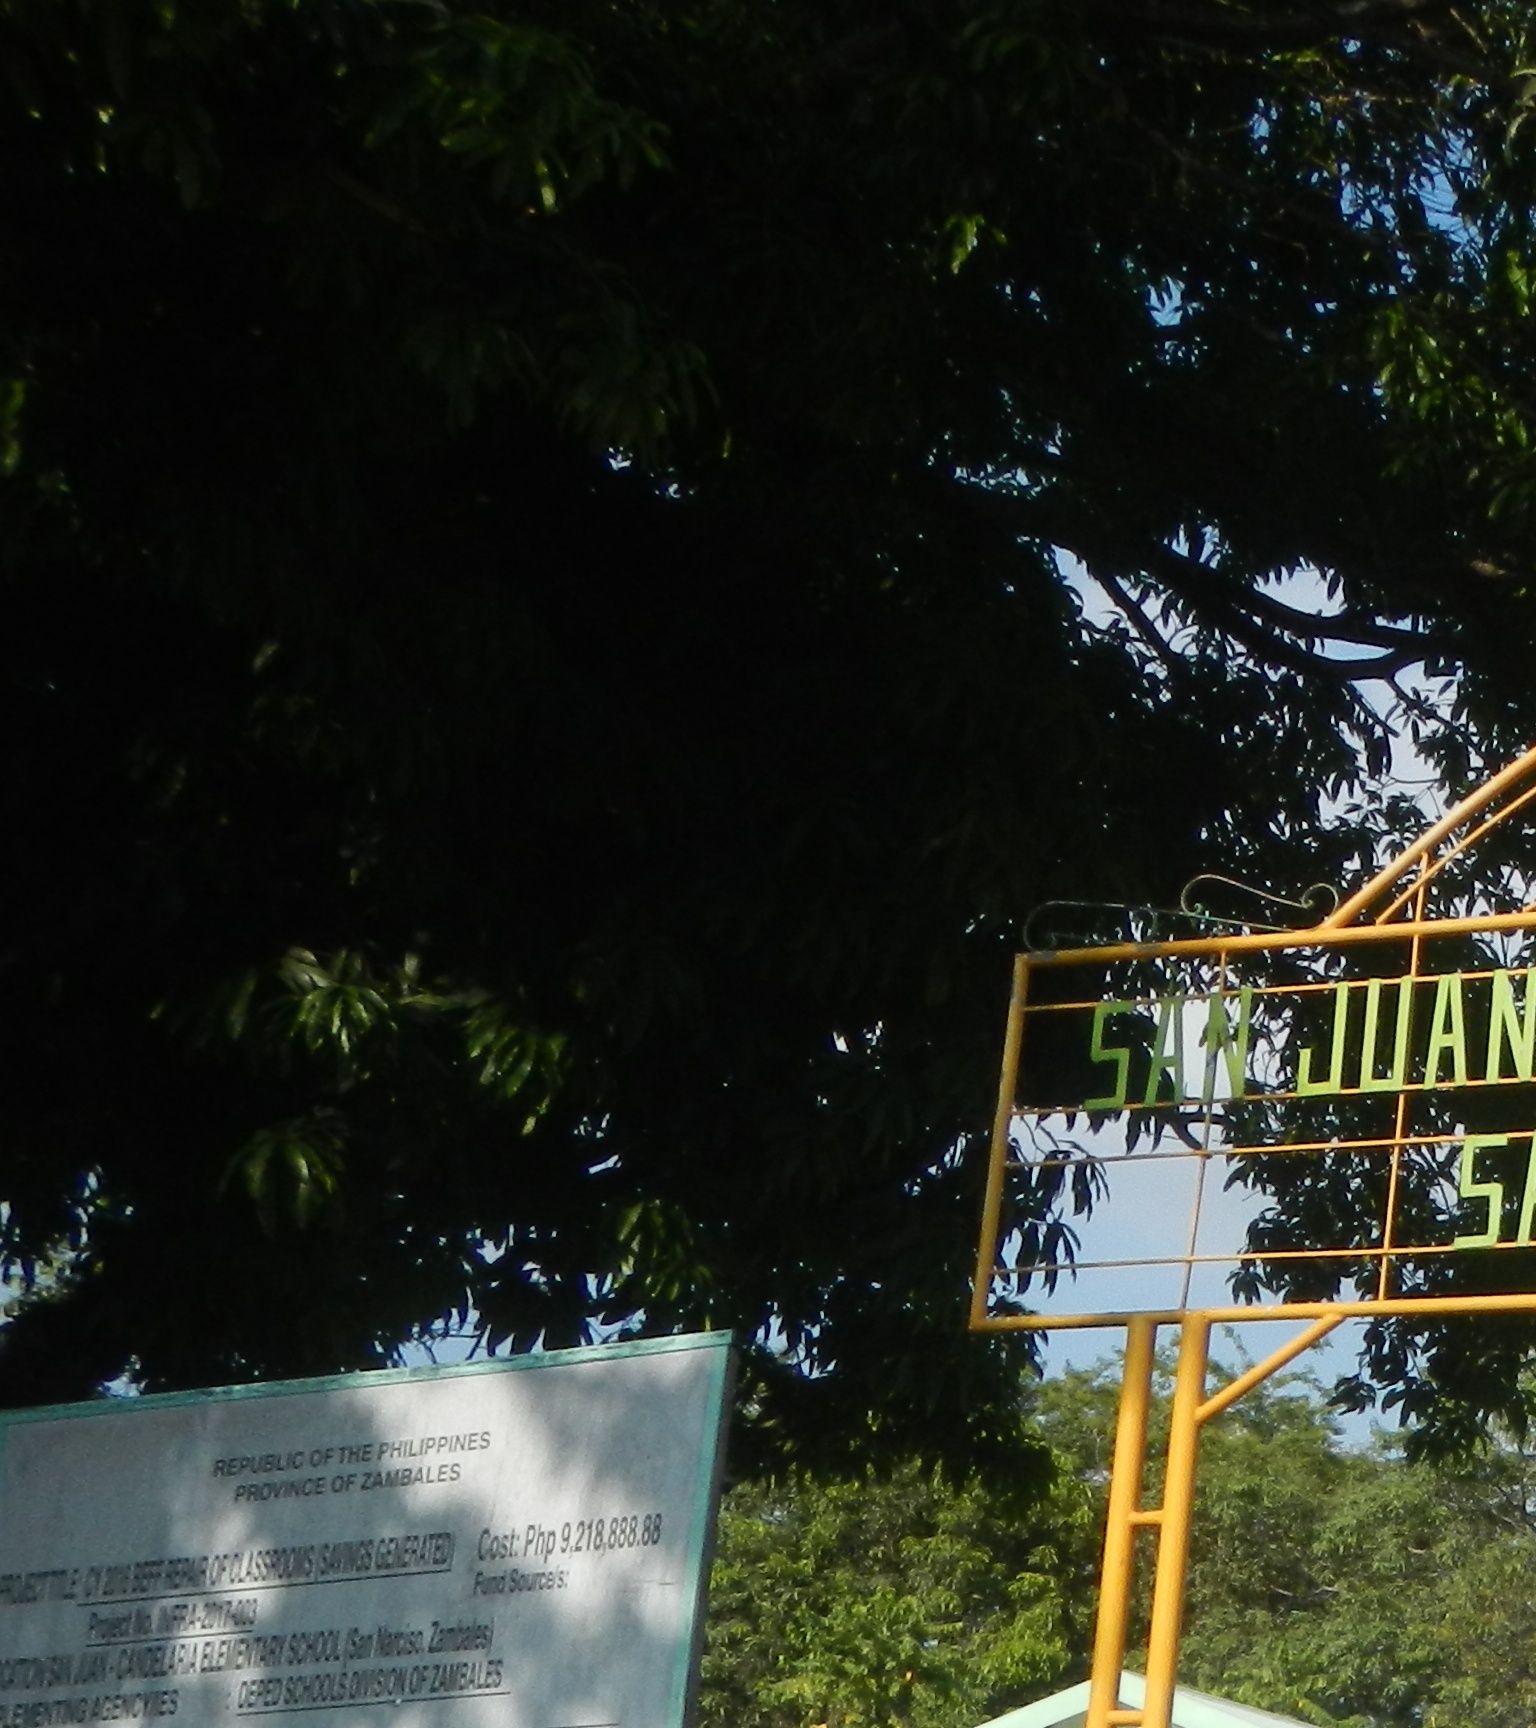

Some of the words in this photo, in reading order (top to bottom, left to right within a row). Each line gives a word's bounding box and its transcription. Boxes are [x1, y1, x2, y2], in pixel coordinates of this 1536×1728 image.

[1083, 988, 1253, 1111] SAN
[212, 1451, 303, 1478] REPUBLIC
[309, 1447, 335, 1467] OF
[338, 1445, 371, 1465] THE
[376, 1431, 491, 1461] PHILIPPINES
[234, 1476, 325, 1503] PROVINCE
[330, 1473, 357, 1494] OF
[360, 1463, 462, 1491] ZAMBALES
[477, 1527, 520, 1562] Cost:
[523, 1524, 556, 1564] Php
